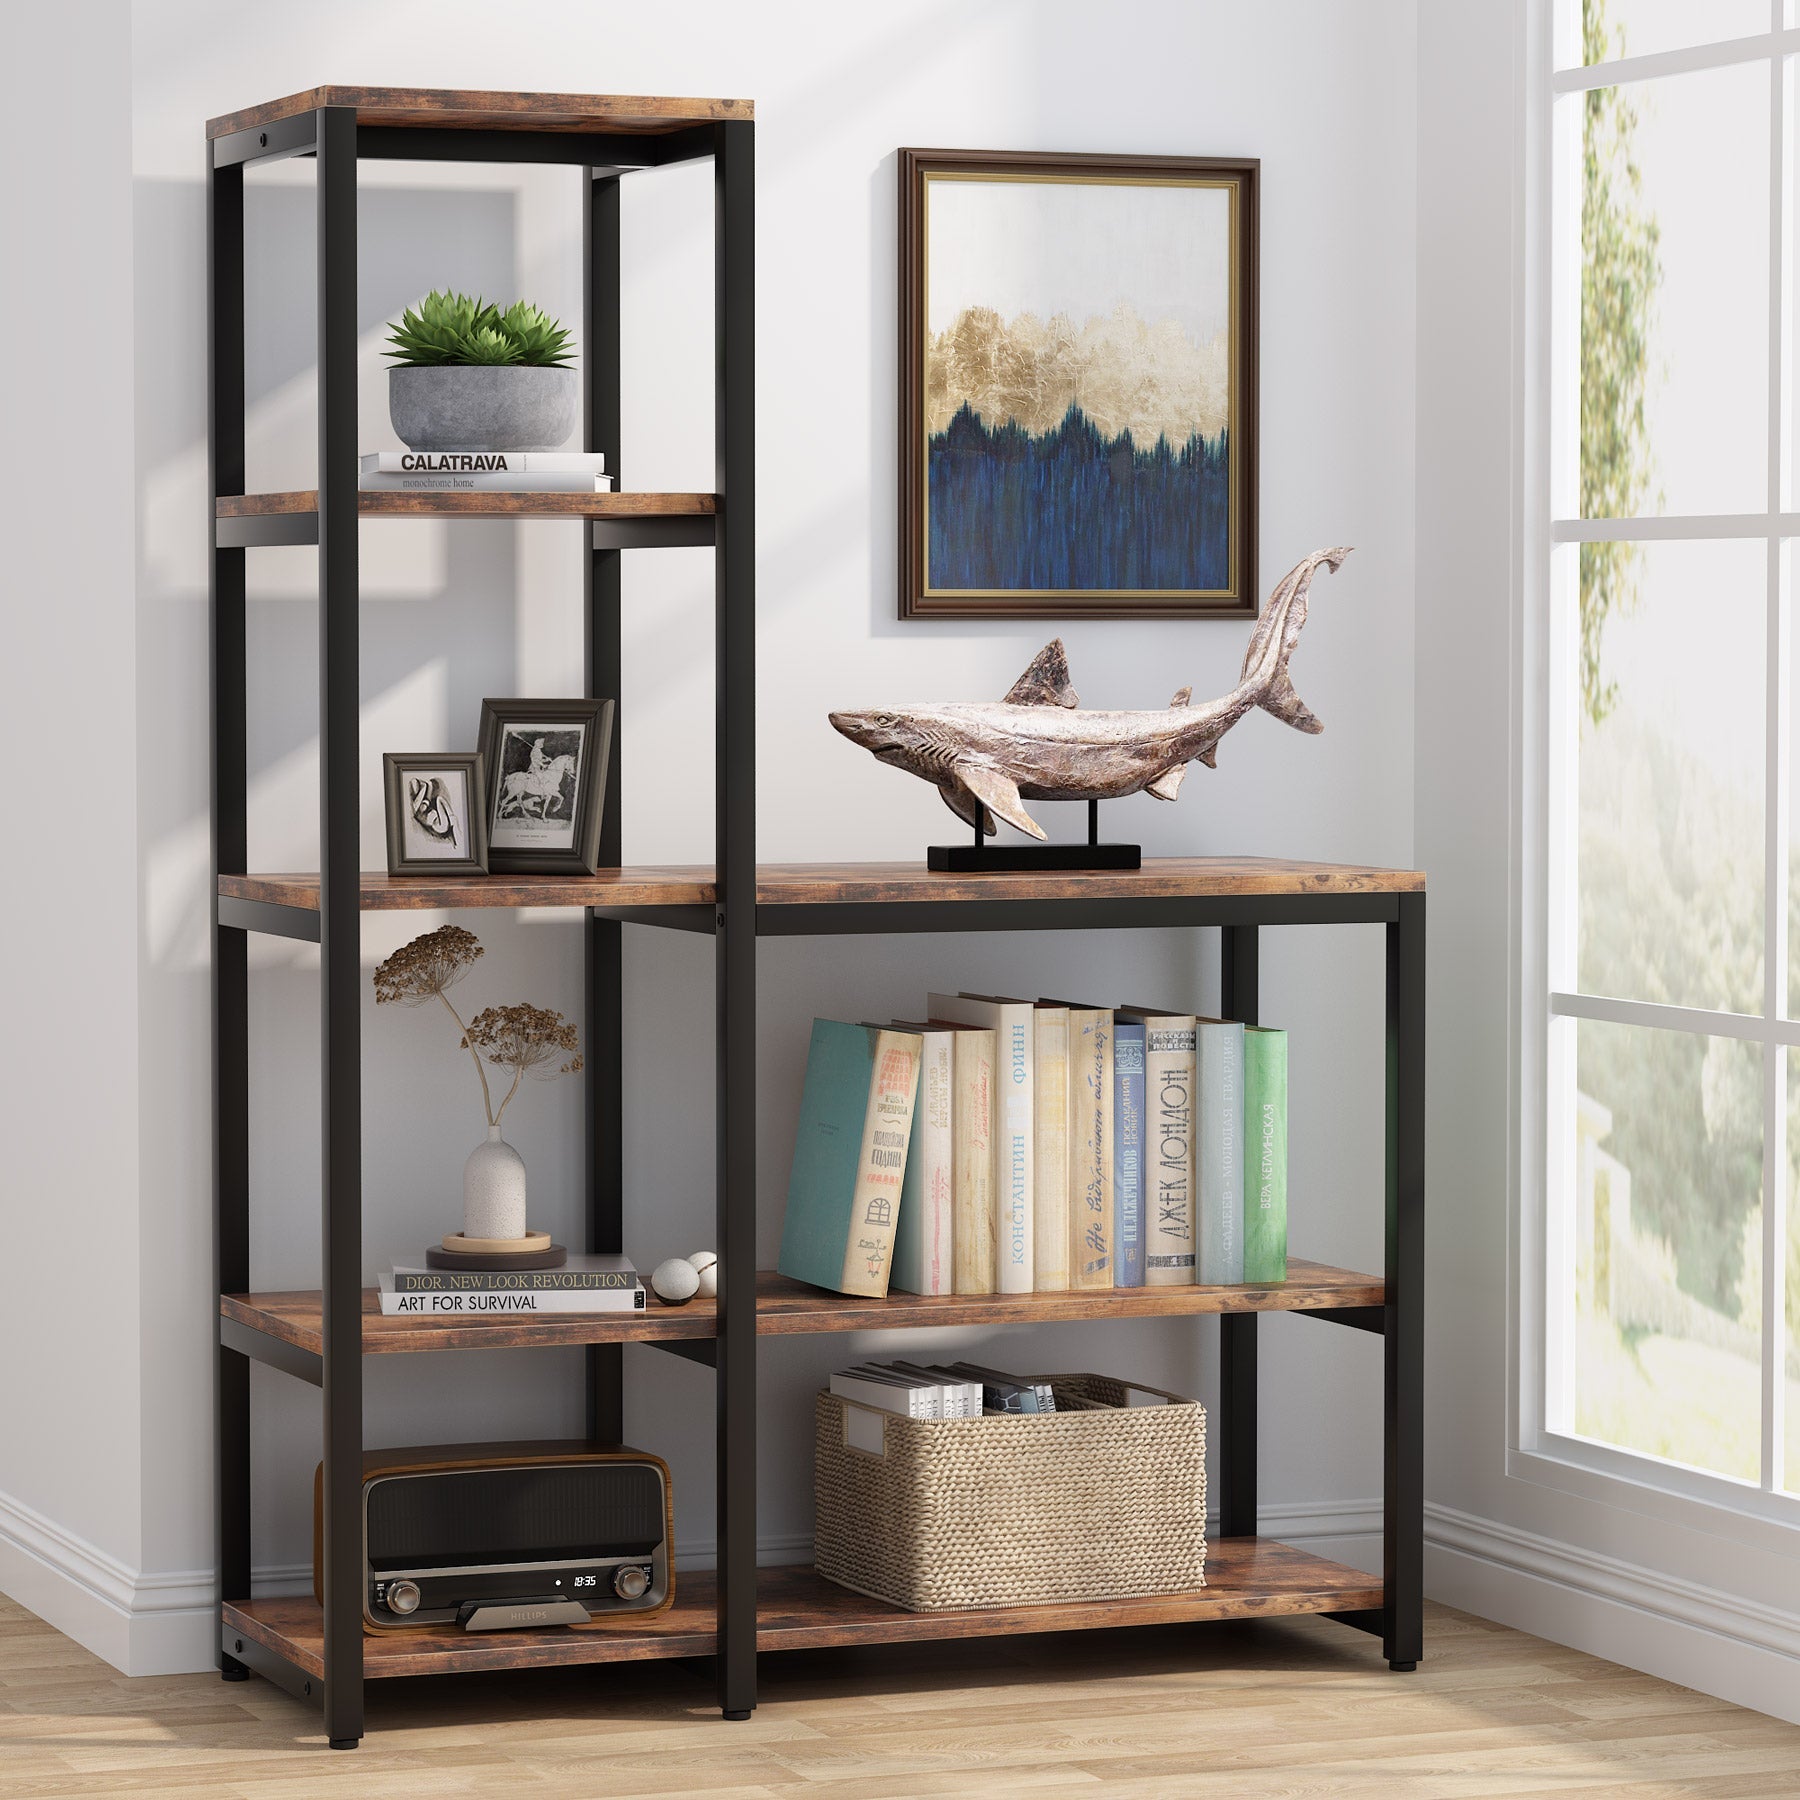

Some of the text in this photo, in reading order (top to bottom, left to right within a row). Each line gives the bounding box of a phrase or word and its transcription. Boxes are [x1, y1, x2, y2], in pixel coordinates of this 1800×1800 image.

[401, 454, 508, 471] CALATRAVA
[402, 477, 474, 488] monochrome home
[1222, 1036, 1235, 1102] ГВАРДИЯ
[1122, 1077, 1132, 1145] ПОСЛЕДНИЙ
[1130, 1107, 1138, 1145] НОВИК
[1012, 1024, 1026, 1265] КОНСТАНТИН ФИНН
[1159, 1069, 1189, 1240] ДЖЕК ЛОНДОН
[1222, 1107, 1234, 1178] МОЛОДАЯ
[1260, 1104, 1275, 1209] ВЕРА КЕТЛИНСКАЯ
[398, 1295, 537, 1311] ART FOR SURVIVAL
[405, 1273, 628, 1290] DIOR. NEW LOOK REVOLUTION
[574, 1575, 596, 1587] 18:35
